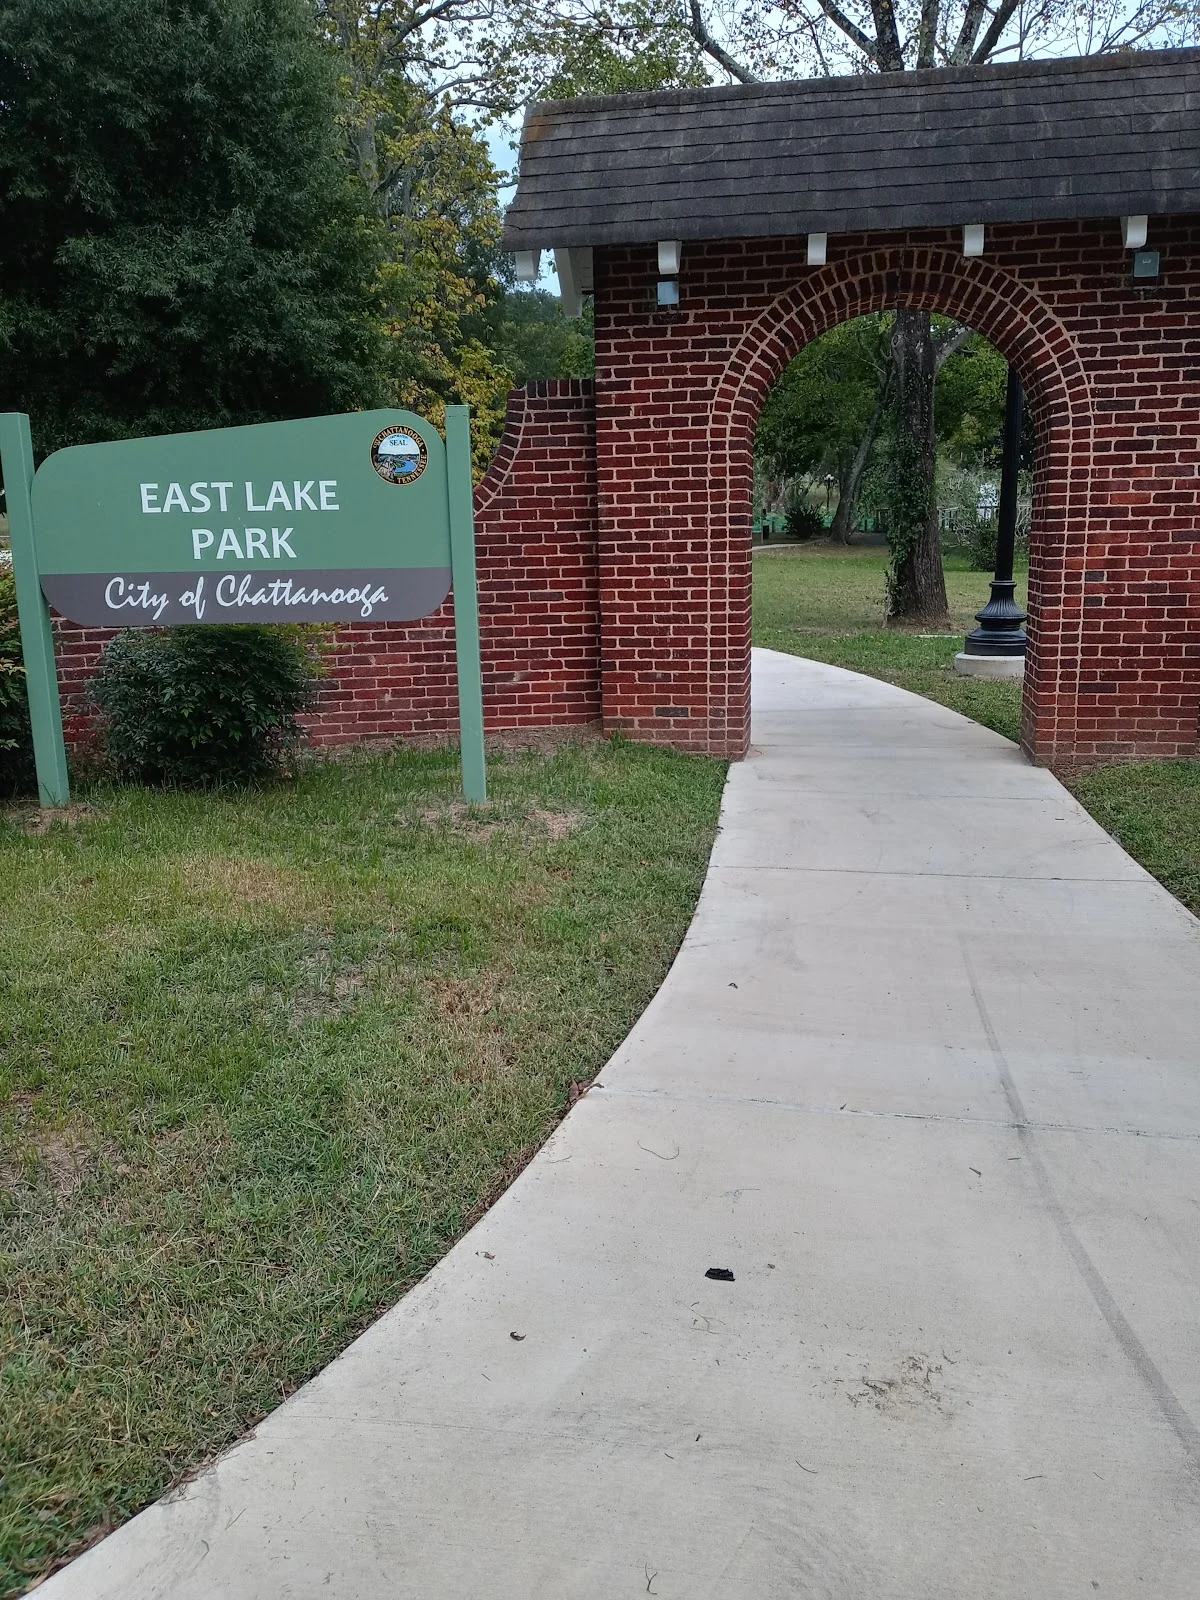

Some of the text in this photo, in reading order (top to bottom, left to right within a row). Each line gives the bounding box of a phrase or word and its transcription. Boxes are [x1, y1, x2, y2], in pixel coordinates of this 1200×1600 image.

[379, 426, 424, 448] CHATTANOOGA
[396, 454, 427, 484] TENNESSEE
[140, 480, 340, 513] EAST LAKE
[191, 528, 297, 559] PARK
[104, 573, 389, 620] City of Chattanooga
